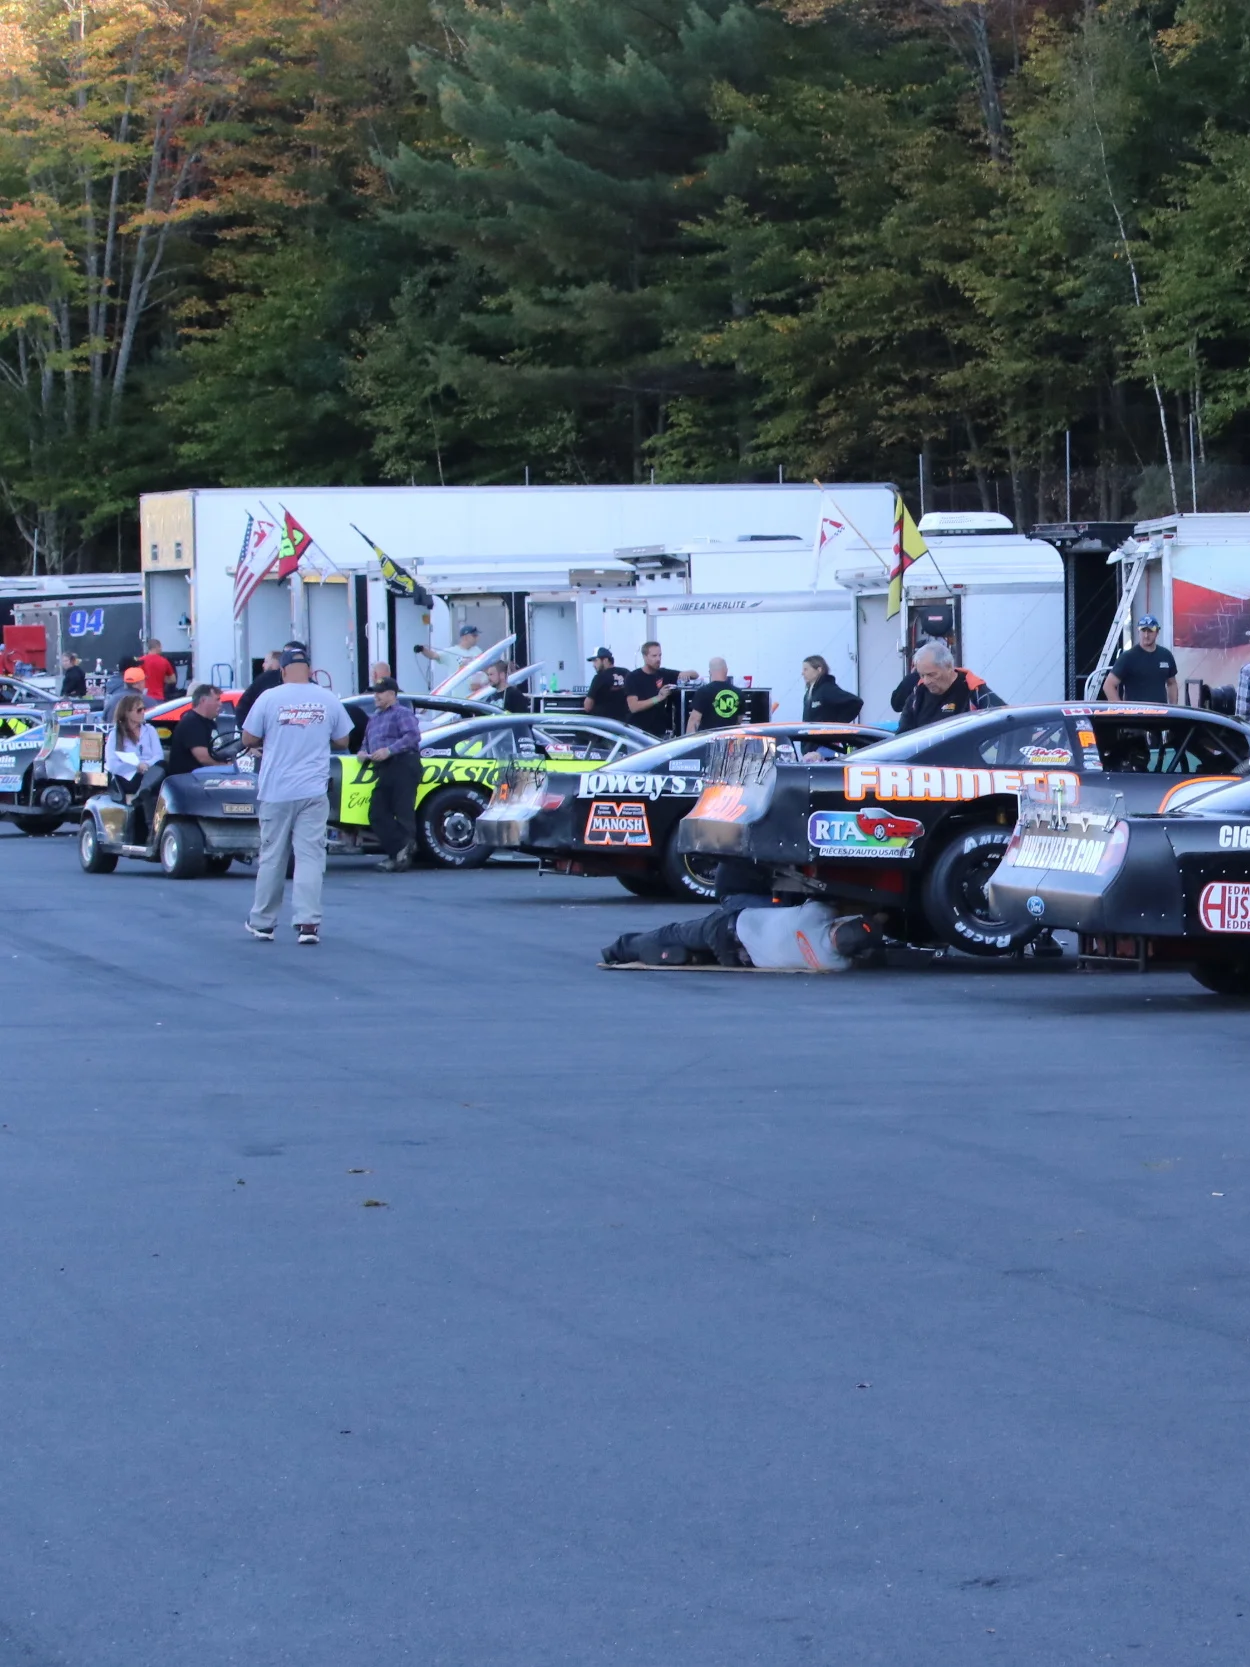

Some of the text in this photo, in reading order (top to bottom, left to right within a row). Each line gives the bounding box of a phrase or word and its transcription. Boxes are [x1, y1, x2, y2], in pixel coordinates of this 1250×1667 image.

[689, 601, 747, 611] FEATHERLITE
[68, 608, 104, 637] 94
[844, 766, 1082, 805] FRAMECO
[592, 818, 643, 831] MANOSH
[815, 820, 867, 842] RTA
[849, 848, 878, 856] D'AUTO
[954, 920, 1012, 949] RACER
